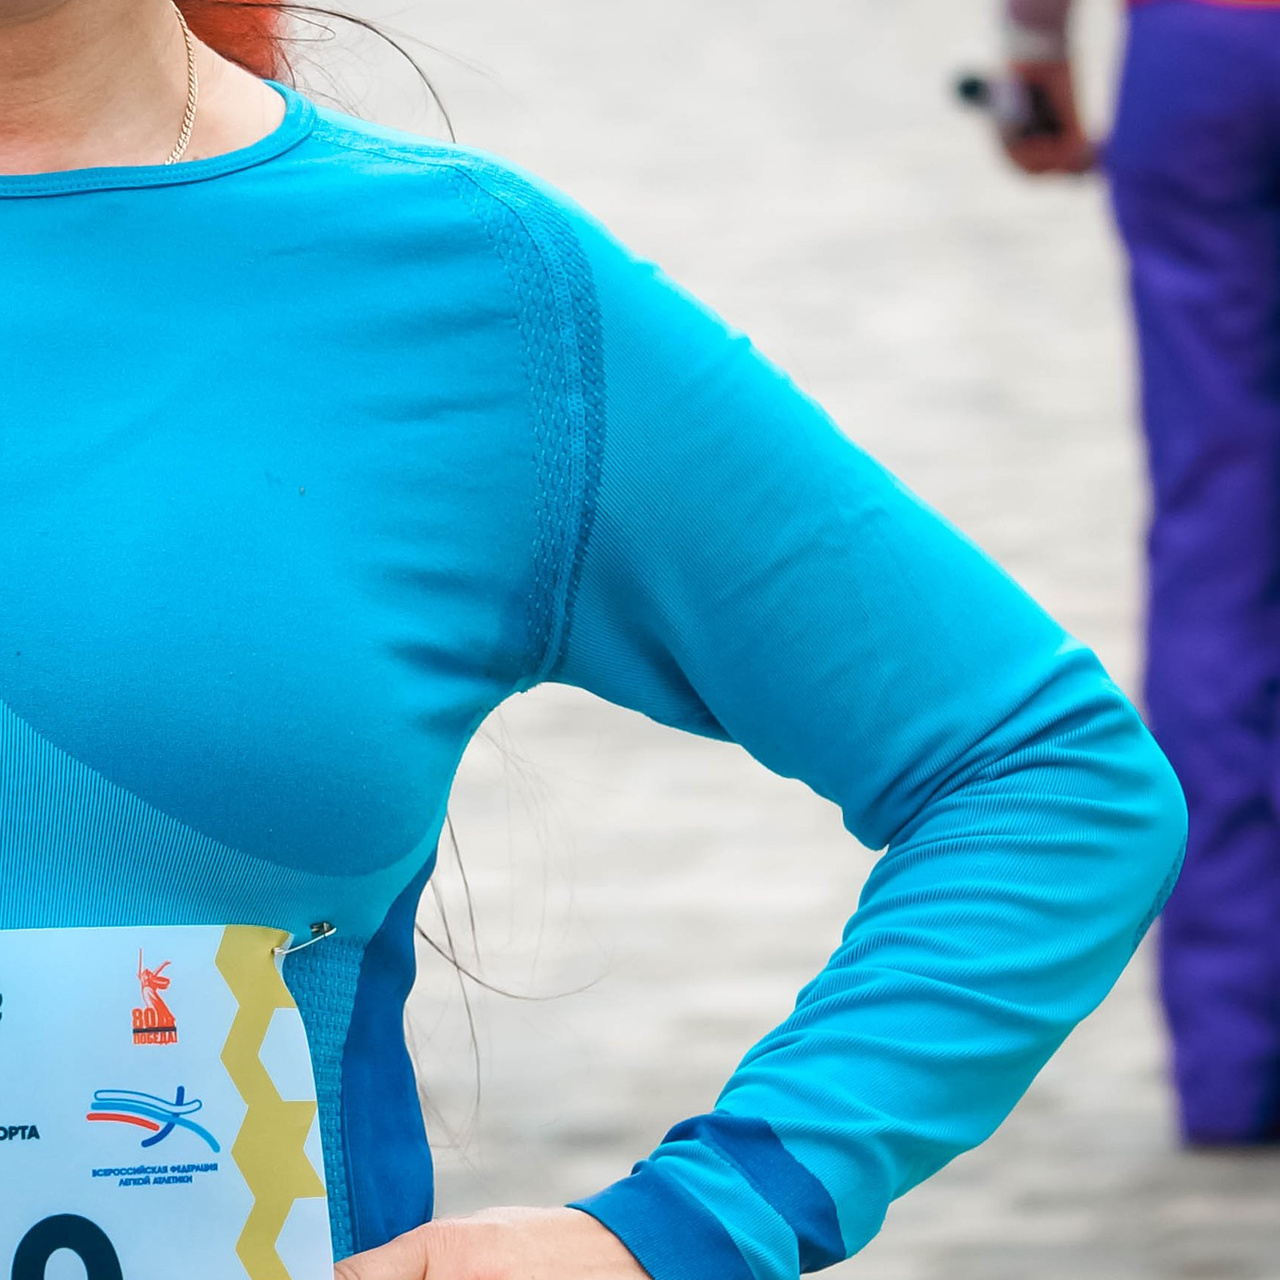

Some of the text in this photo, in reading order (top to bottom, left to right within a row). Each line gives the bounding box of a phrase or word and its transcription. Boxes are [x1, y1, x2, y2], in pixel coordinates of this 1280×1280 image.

[132, 1008, 156, 1028] 80
[92, 1163, 218, 1177] ВСЕРОССИЙСКАЯ ФЕДЕРАЦИЯ
[118, 1175, 193, 1187] ЛЕГКОЙ АТЛЕТИКИ
